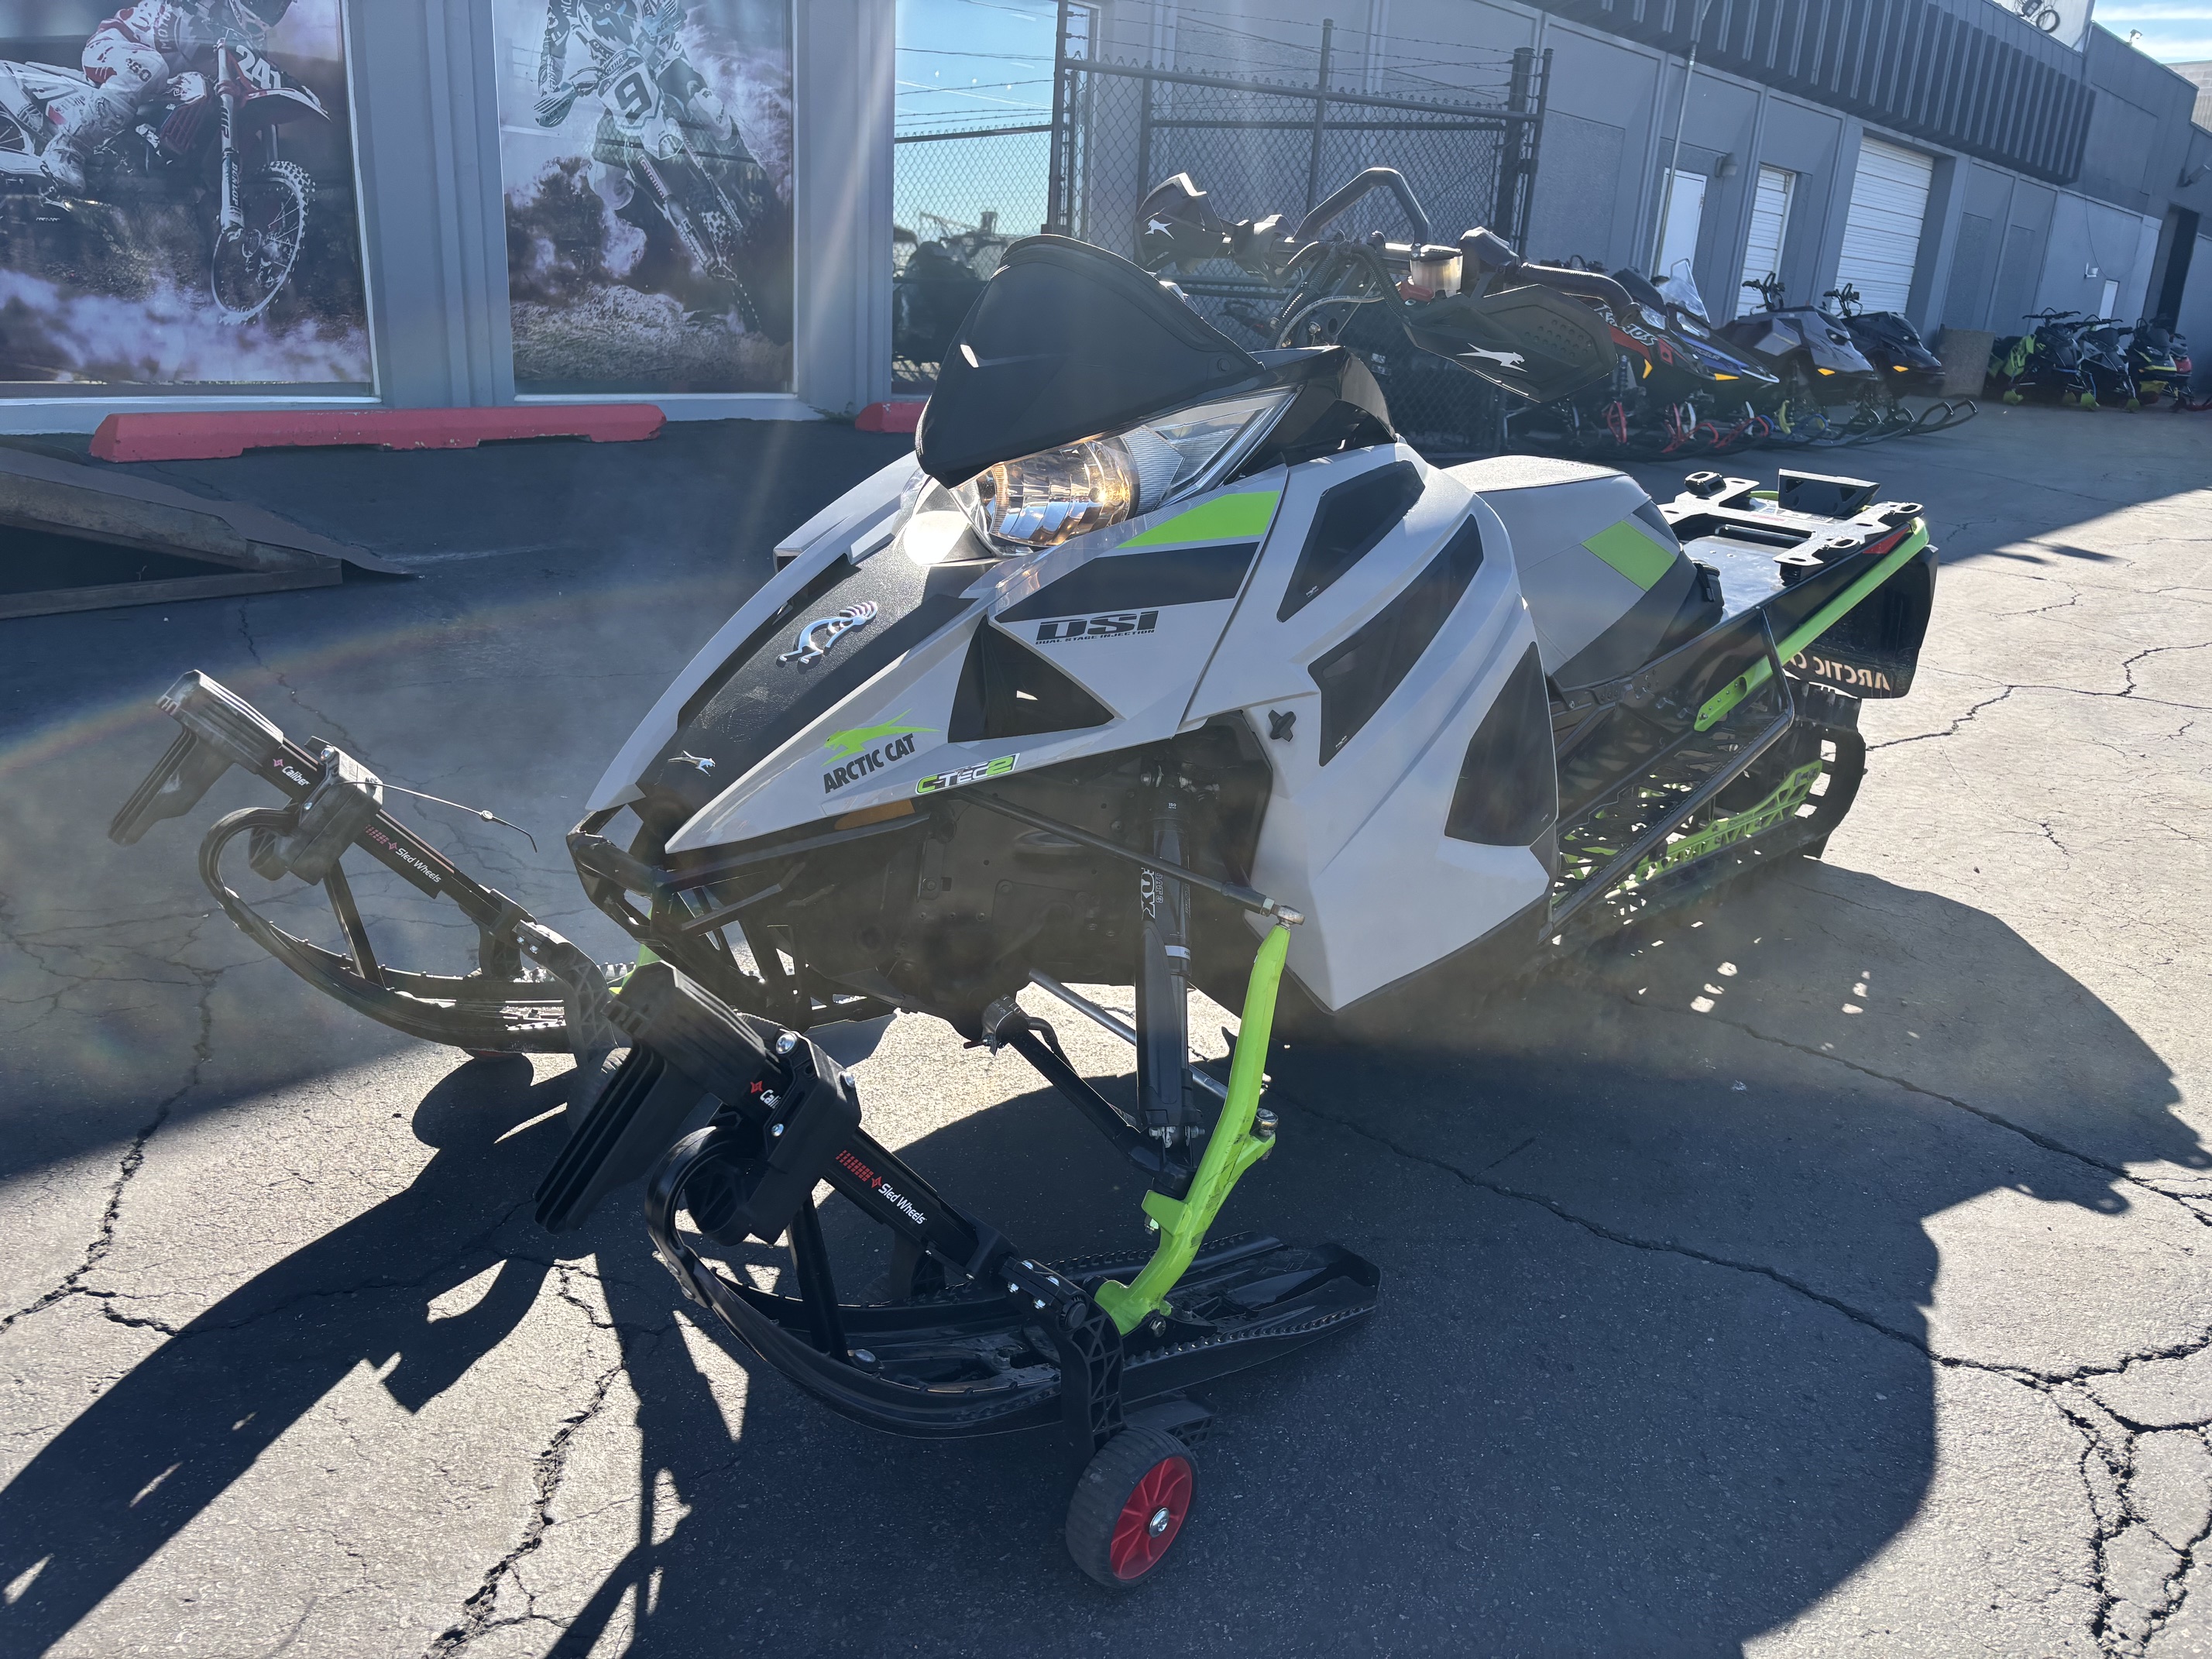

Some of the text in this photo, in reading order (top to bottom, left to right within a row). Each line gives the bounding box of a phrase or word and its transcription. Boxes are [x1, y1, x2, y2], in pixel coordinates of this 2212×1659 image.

[614, 71, 652, 125] 9
[1036, 610, 1159, 641] DSI
[1100, 629, 1155, 638] INJECTION
[282, 766, 310, 786] Caliber
[823, 733, 916, 794] ARCTIC CAT
[395, 847, 441, 883] Sled Wheels
[760, 1089, 781, 1109] Cali
[878, 1183, 926, 1224] Sled Wheels
